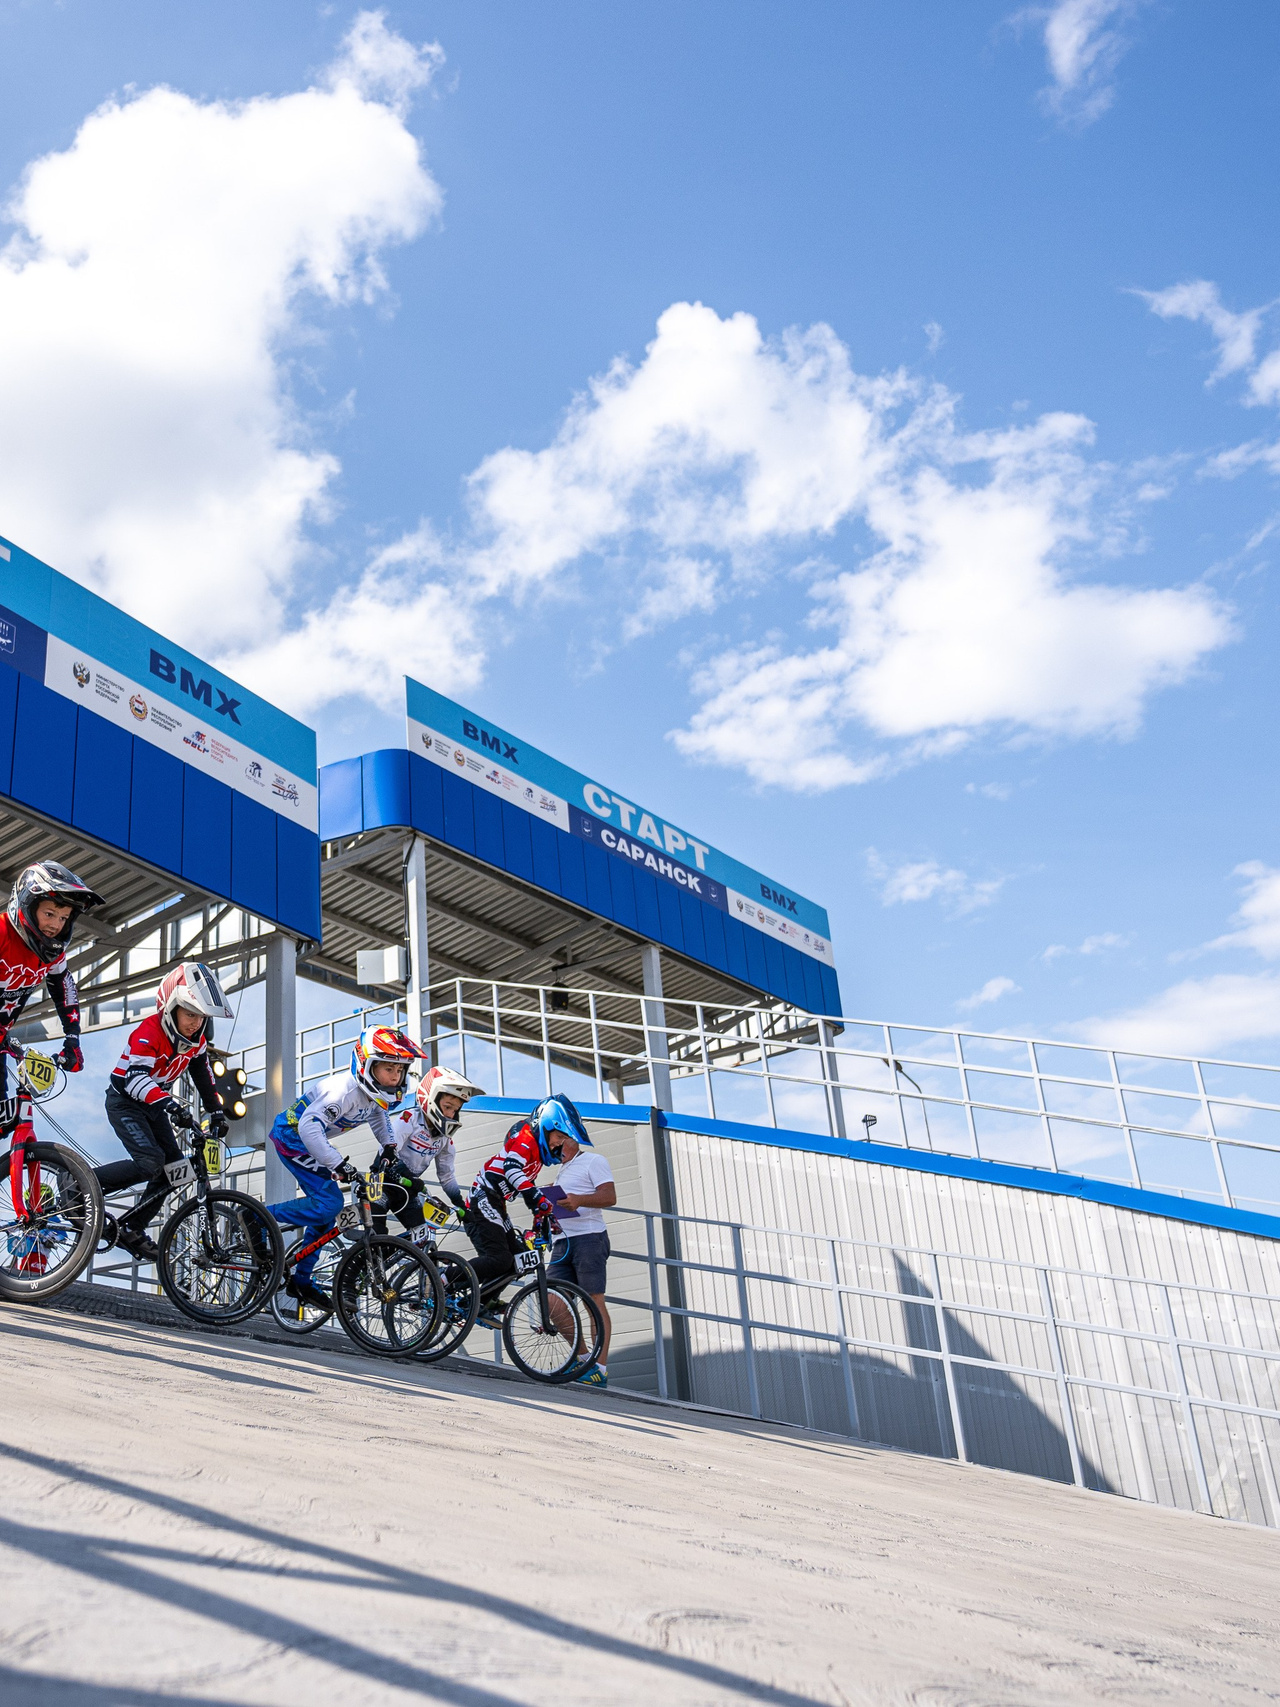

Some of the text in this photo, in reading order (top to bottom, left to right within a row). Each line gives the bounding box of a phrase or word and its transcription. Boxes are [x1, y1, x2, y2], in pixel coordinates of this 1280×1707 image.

[149, 648, 241, 726] BMX
[462, 718, 519, 765] BMX
[582, 783, 709, 871] СТАРТ
[600, 829, 702, 894] САРАНСК
[760, 883, 798, 915] BMX
[29, 1060, 51, 1083] 120
[208, 1146, 218, 1165] 127
[169, 1165, 188, 1182] 127
[84, 1193, 93, 1227] AVIAN
[339, 1211, 358, 1228] 82
[295, 1227, 339, 1262] MEYBO
[520, 1251, 538, 1268] 145
